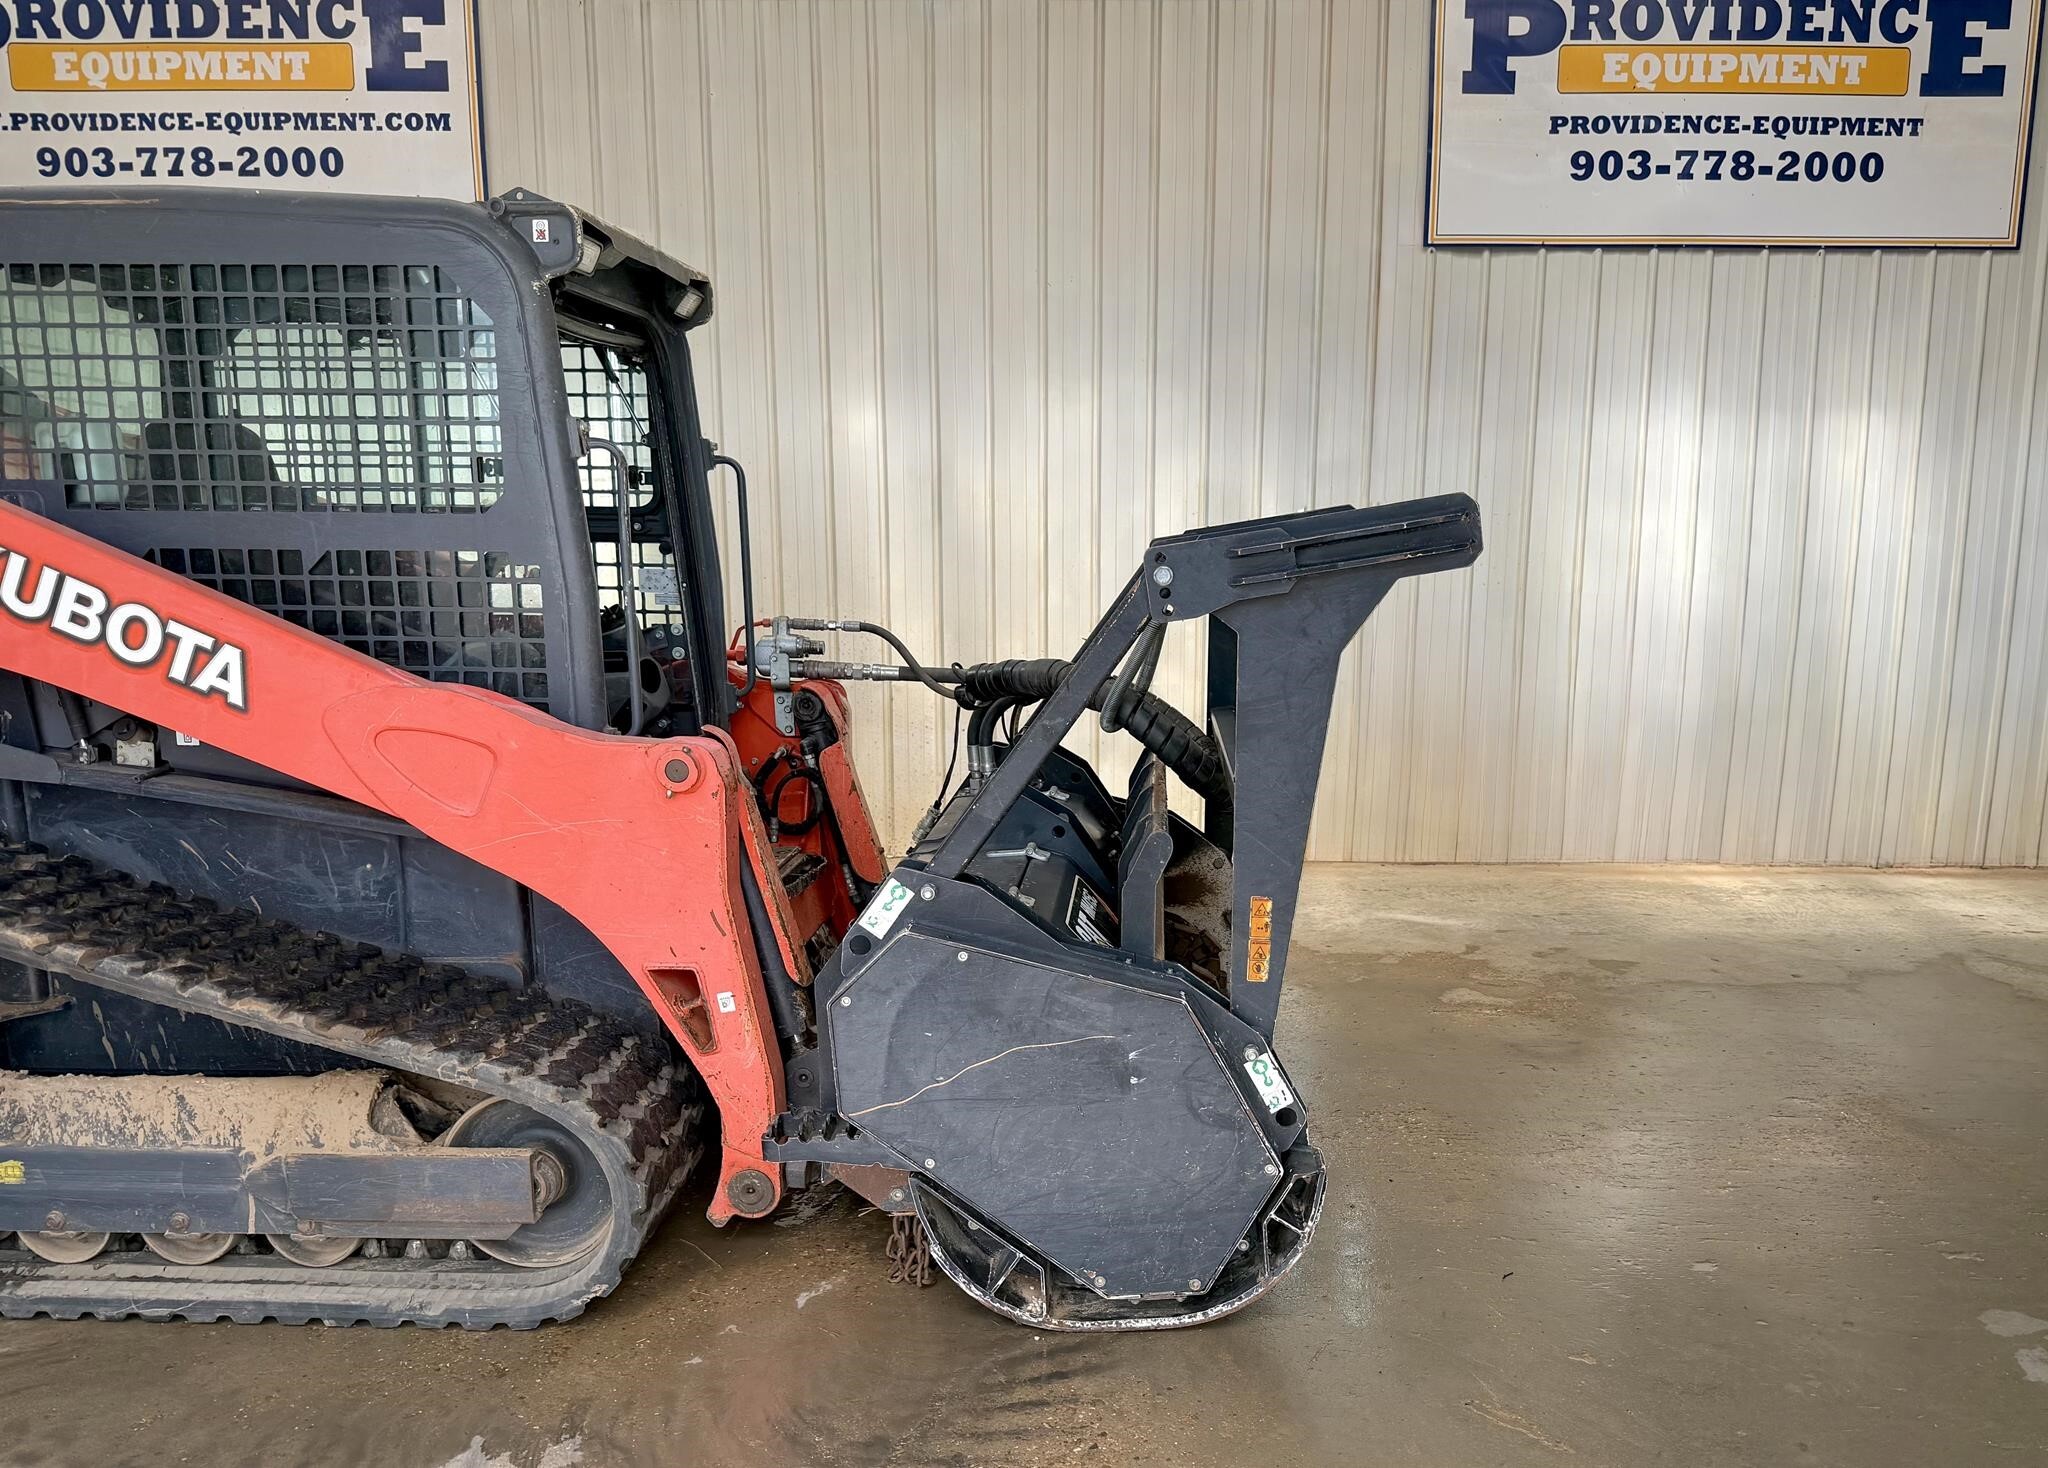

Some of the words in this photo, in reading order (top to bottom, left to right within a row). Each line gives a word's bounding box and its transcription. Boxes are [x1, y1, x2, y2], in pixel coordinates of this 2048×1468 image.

[0, 0, 449, 92] ROVIDENCE
[1462, 0, 2012, 97] PROVIDENCE
[52, 51, 310, 90] EQUIPMENT
[1602, 52, 1868, 91] EQUIPMENT
[0, 112, 452, 136] .PROVIDENCE-EQUIPMENT.COM
[1549, 115, 1924, 140] PROVIDENCE-EQUIPMENT
[36, 146, 344, 178] 903-778-2000
[1569, 149, 1885, 183] 903-778-2000
[0, 547, 247, 711] UBOTA
